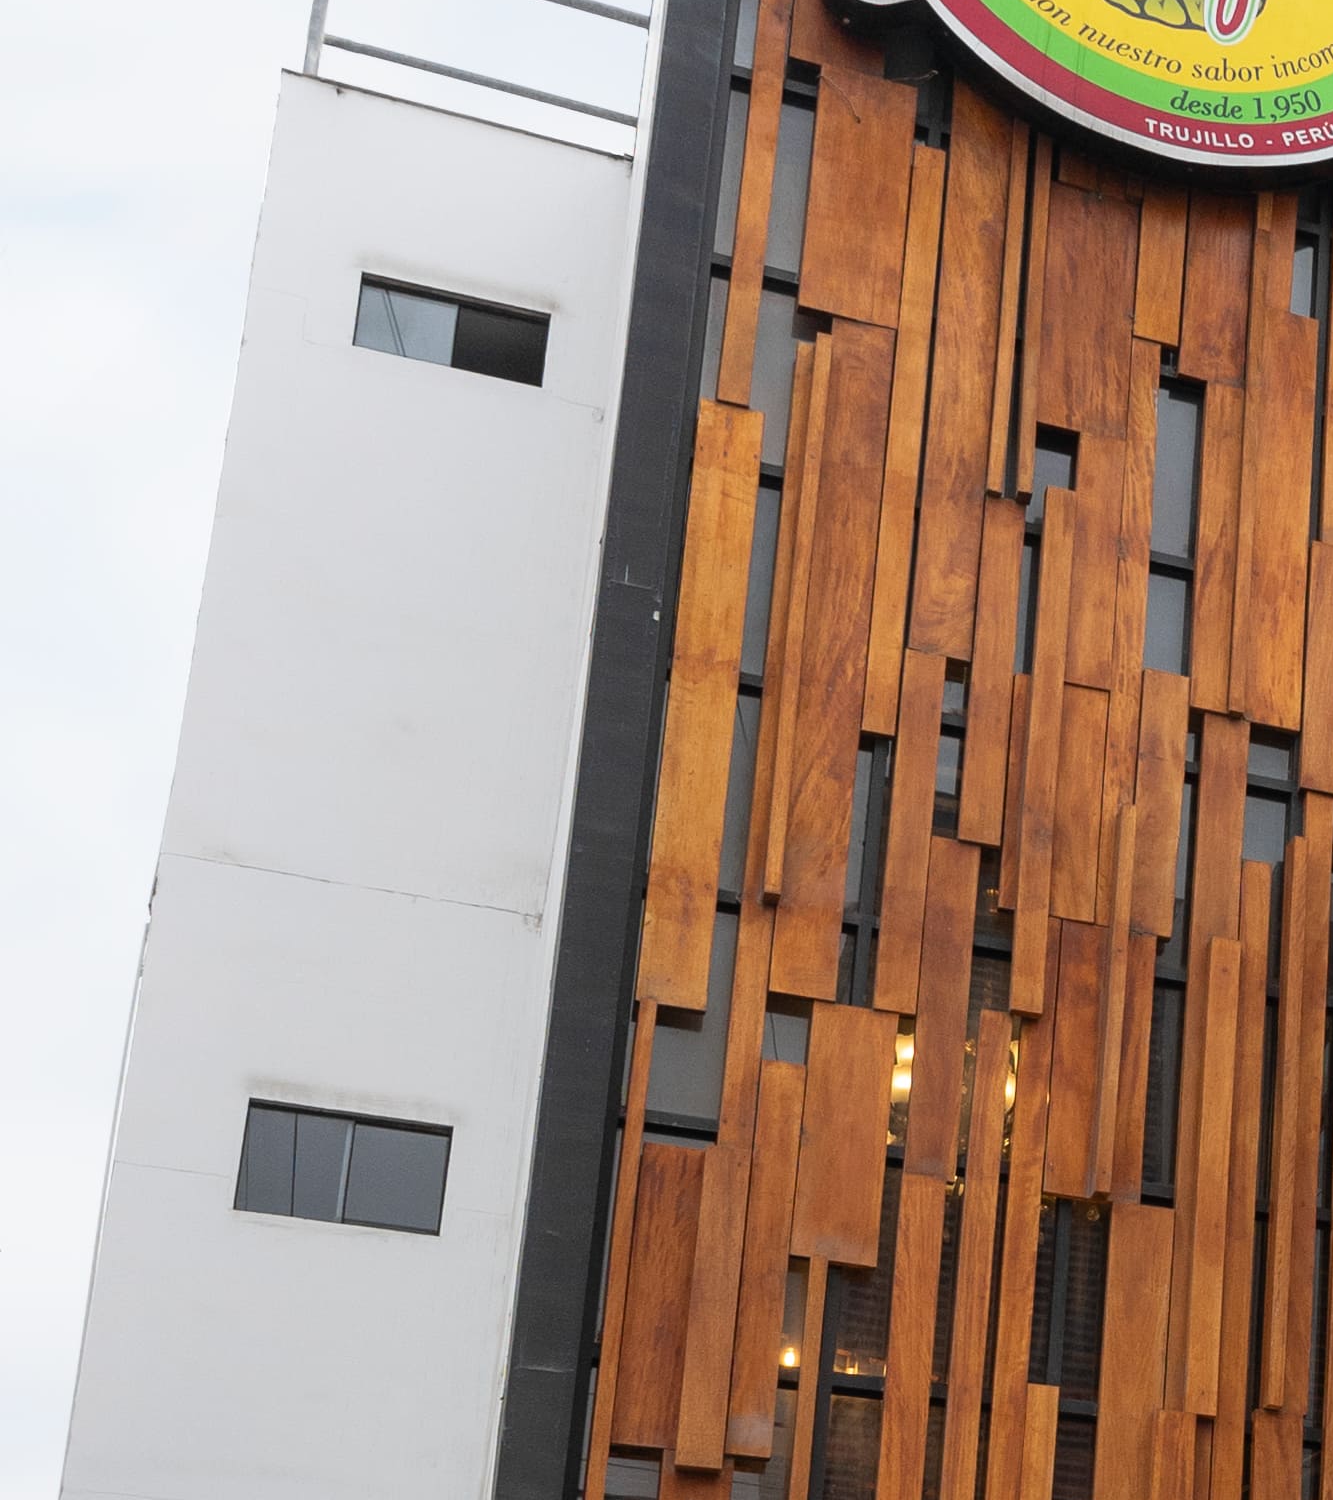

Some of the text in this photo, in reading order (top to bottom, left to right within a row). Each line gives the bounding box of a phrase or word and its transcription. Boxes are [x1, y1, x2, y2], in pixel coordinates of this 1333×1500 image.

[1078, 22, 1183, 75] nuestro
[1192, 58, 1264, 83] sabor
[1170, 89, 1322, 124] desde 1,950
[1144, 118, 1255, 150] TRUJILLO
